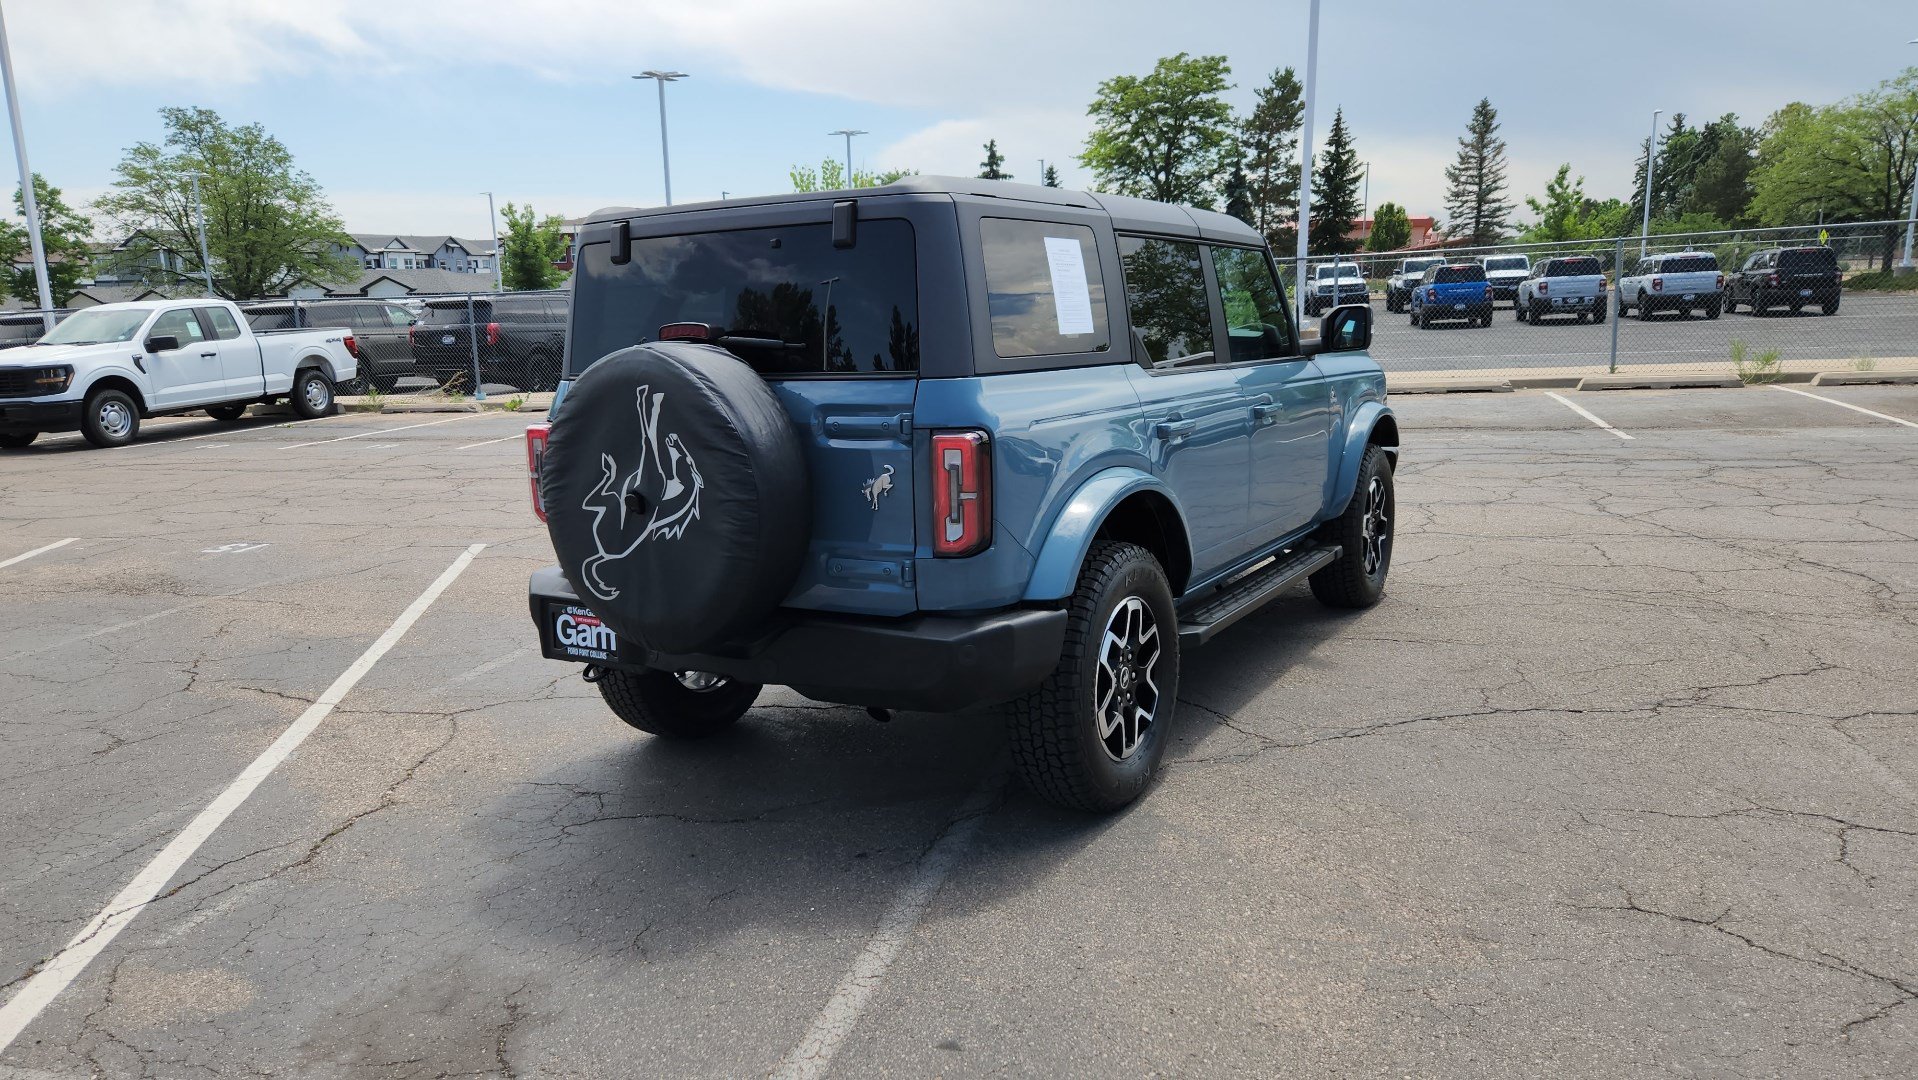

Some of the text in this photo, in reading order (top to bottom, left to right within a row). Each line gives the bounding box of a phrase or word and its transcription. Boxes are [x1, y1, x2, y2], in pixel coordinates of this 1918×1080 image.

[567, 647, 607, 660] FORD FORT COLLINS
